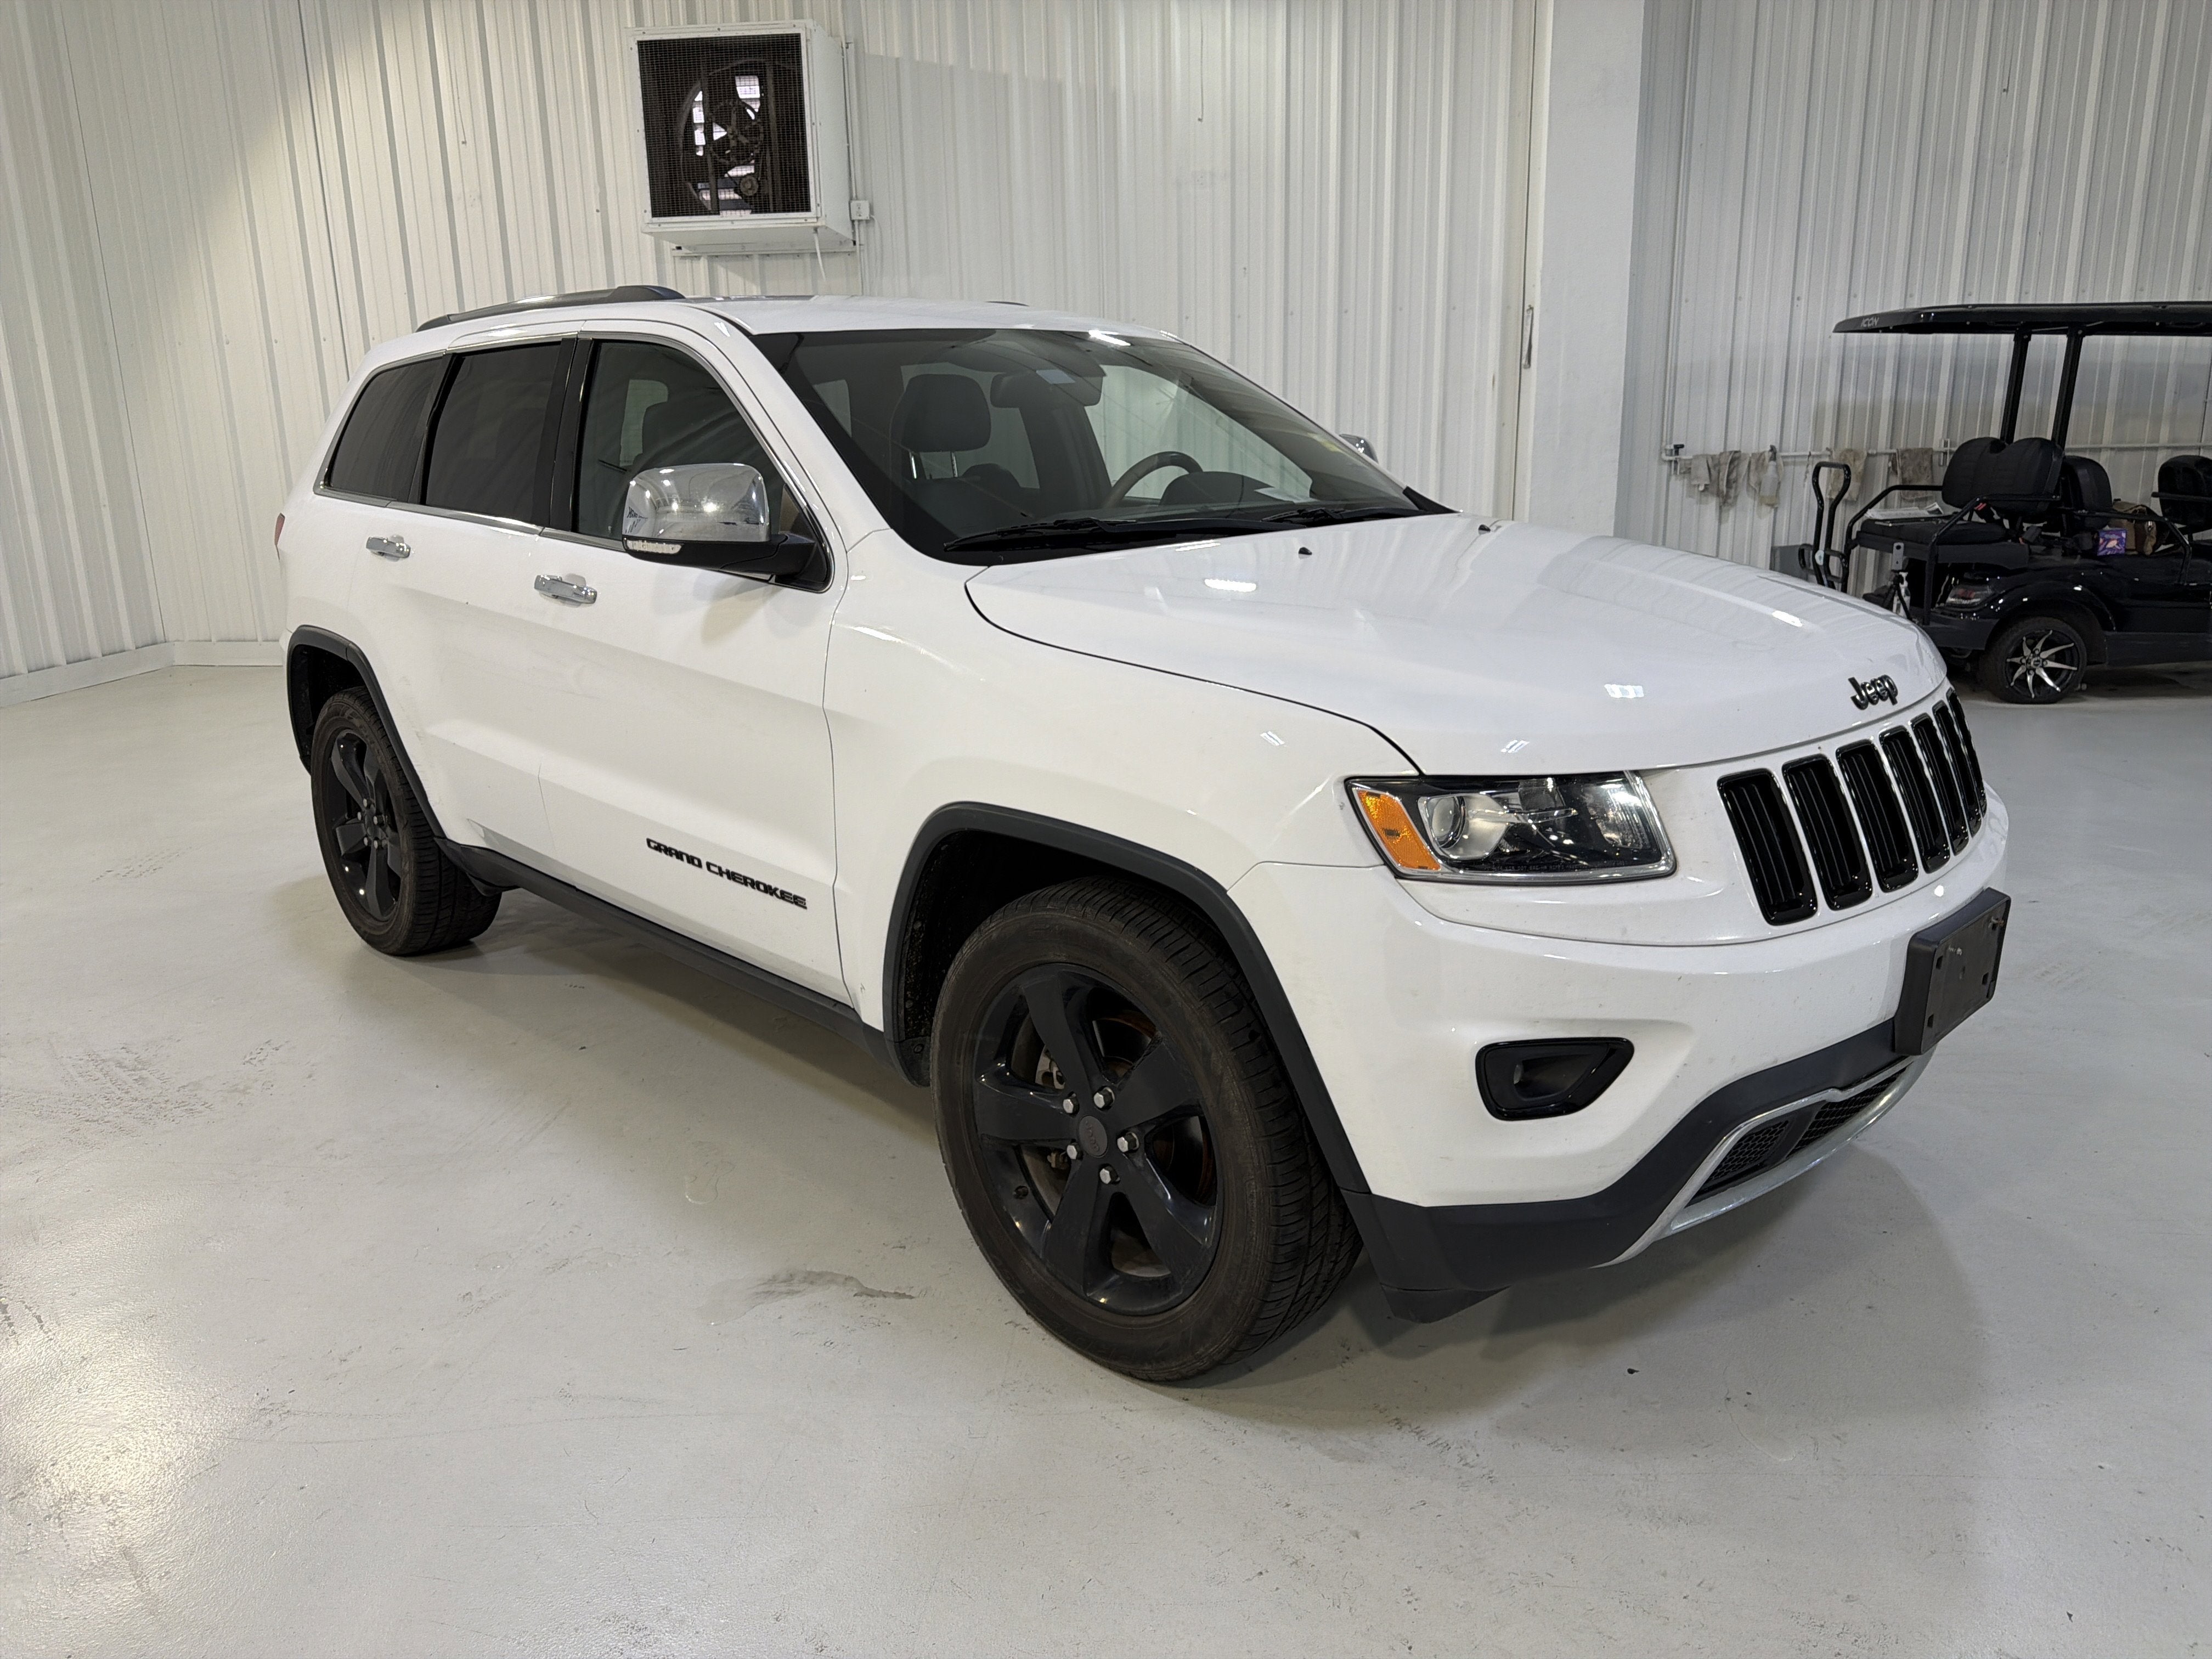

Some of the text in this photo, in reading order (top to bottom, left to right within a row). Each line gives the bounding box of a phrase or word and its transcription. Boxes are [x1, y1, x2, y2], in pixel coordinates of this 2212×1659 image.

[1848, 674, 1898, 710] Jeep
[646, 838, 808, 910] GRAND CHEROKEE
